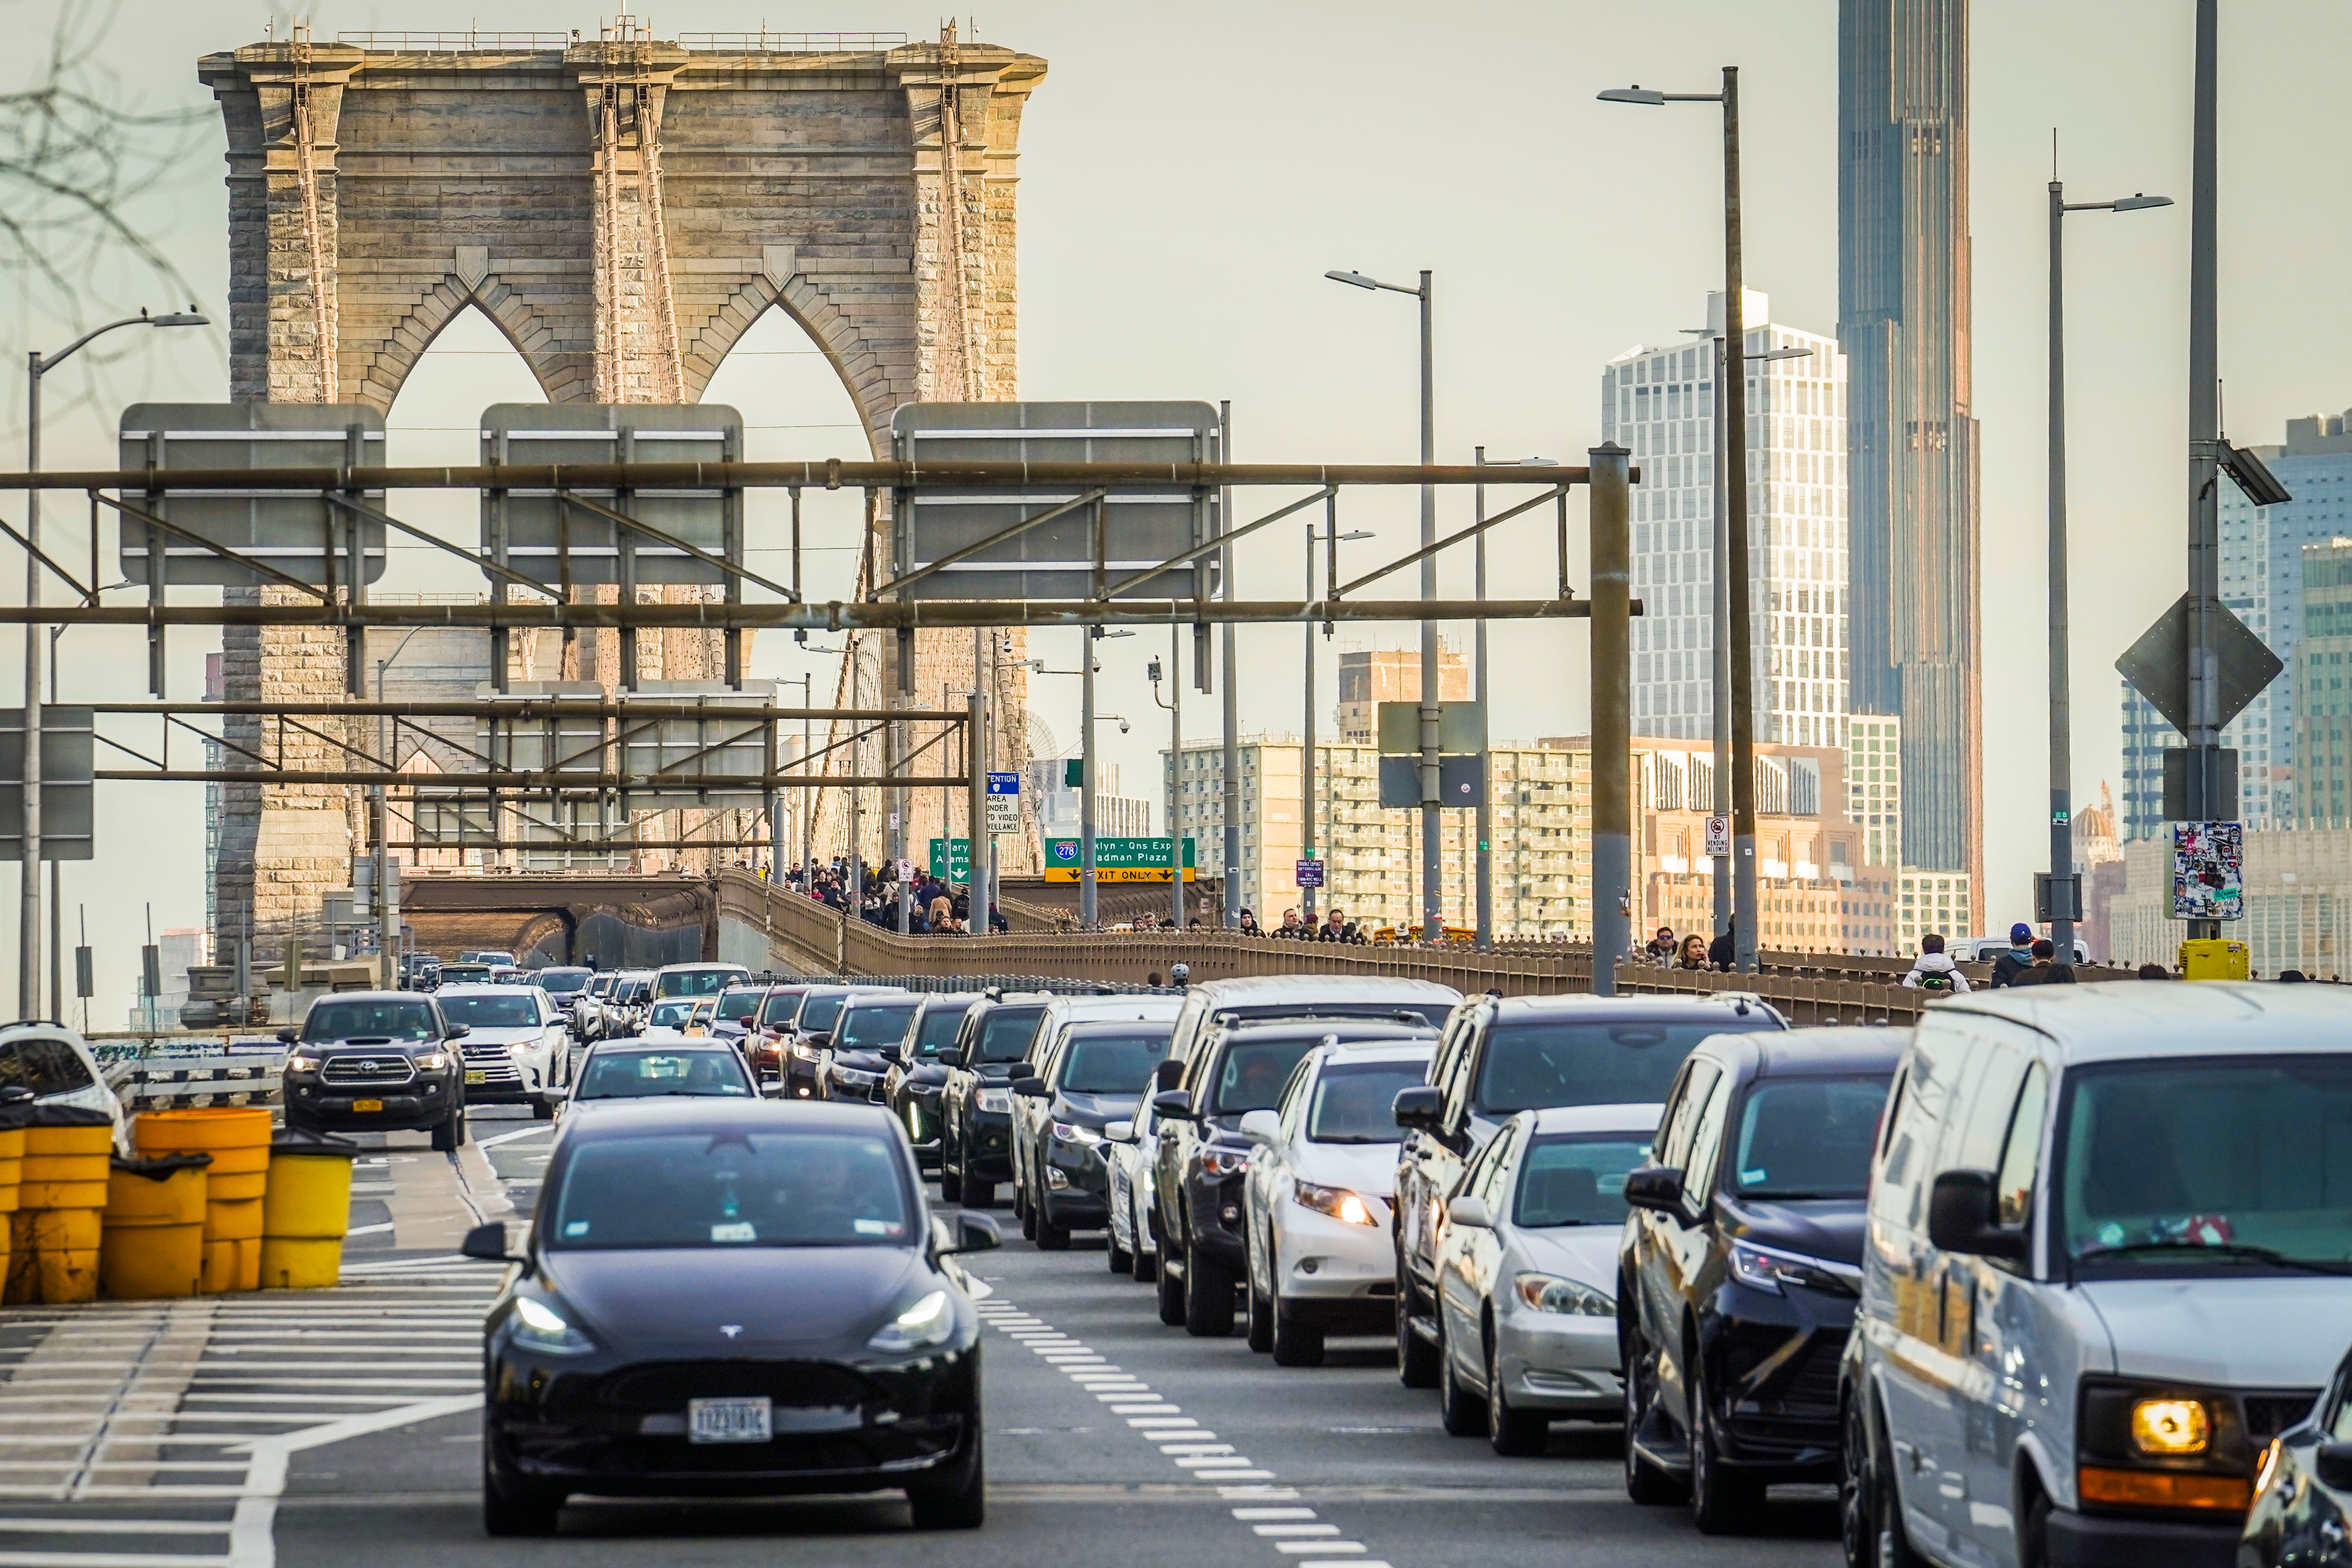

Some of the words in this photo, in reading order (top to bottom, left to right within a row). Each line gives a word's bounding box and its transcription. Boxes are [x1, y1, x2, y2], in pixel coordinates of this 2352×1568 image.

[937, 843, 968, 853] Tary
[1096, 842, 1115, 851] klyn
[1153, 842, 1185, 851] Expy
[1059, 847, 1074, 856] 278
[1097, 853, 1132, 861] adman
[1138, 853, 1167, 861] Plaza
[1097, 871, 1115, 880] XIT
[1122, 871, 1151, 880] ONLY
